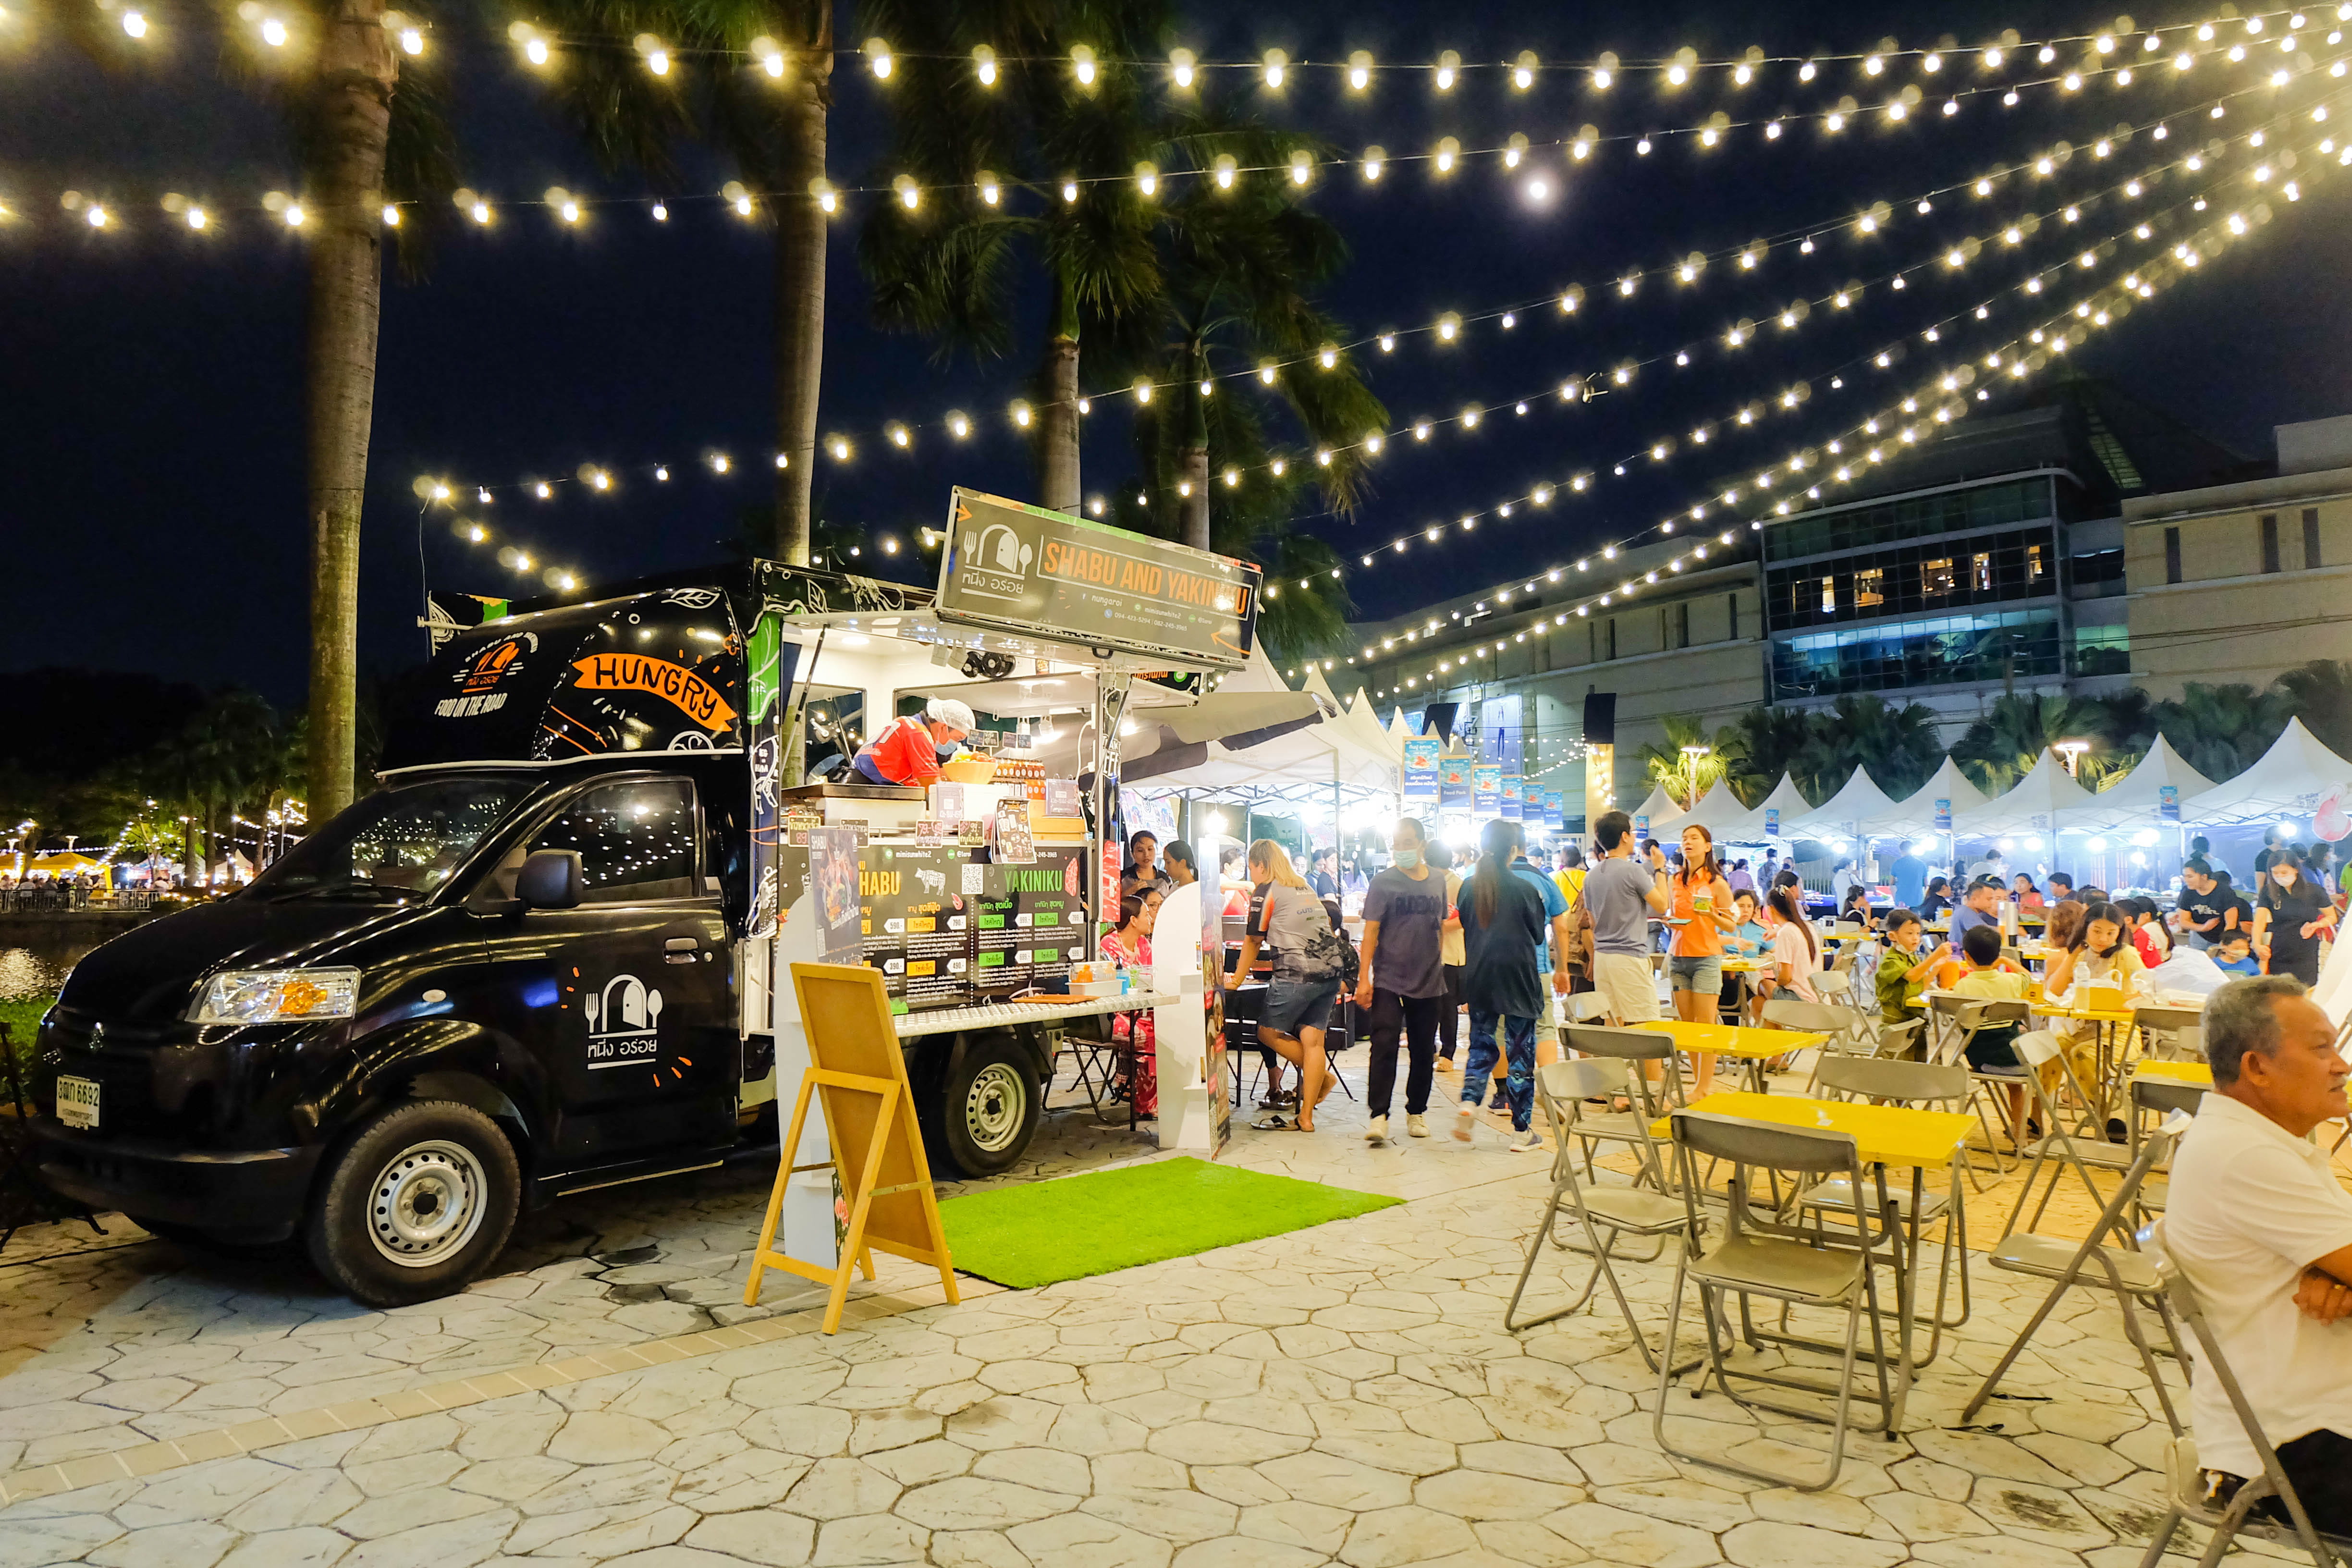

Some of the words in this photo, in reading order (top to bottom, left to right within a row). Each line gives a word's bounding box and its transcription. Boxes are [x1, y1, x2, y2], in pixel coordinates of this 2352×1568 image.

[1044, 542, 1117, 586] SHABU
[1119, 561, 1163, 595] AND
[991, 578, 1024, 594] อร่อย
[1091, 595, 1123, 607] nungaroi
[594, 657, 717, 721] HUNGRY
[434, 698, 457, 717] FOOD
[453, 697, 470, 717] ON
[465, 695, 486, 717] THE
[480, 693, 507, 714] ROAD
[859, 871, 901, 896] HABU
[1004, 870, 1063, 893] YAKINIKU
[620, 1039, 657, 1055] อร่อย
[77, 1084, 99, 1107] 6692
